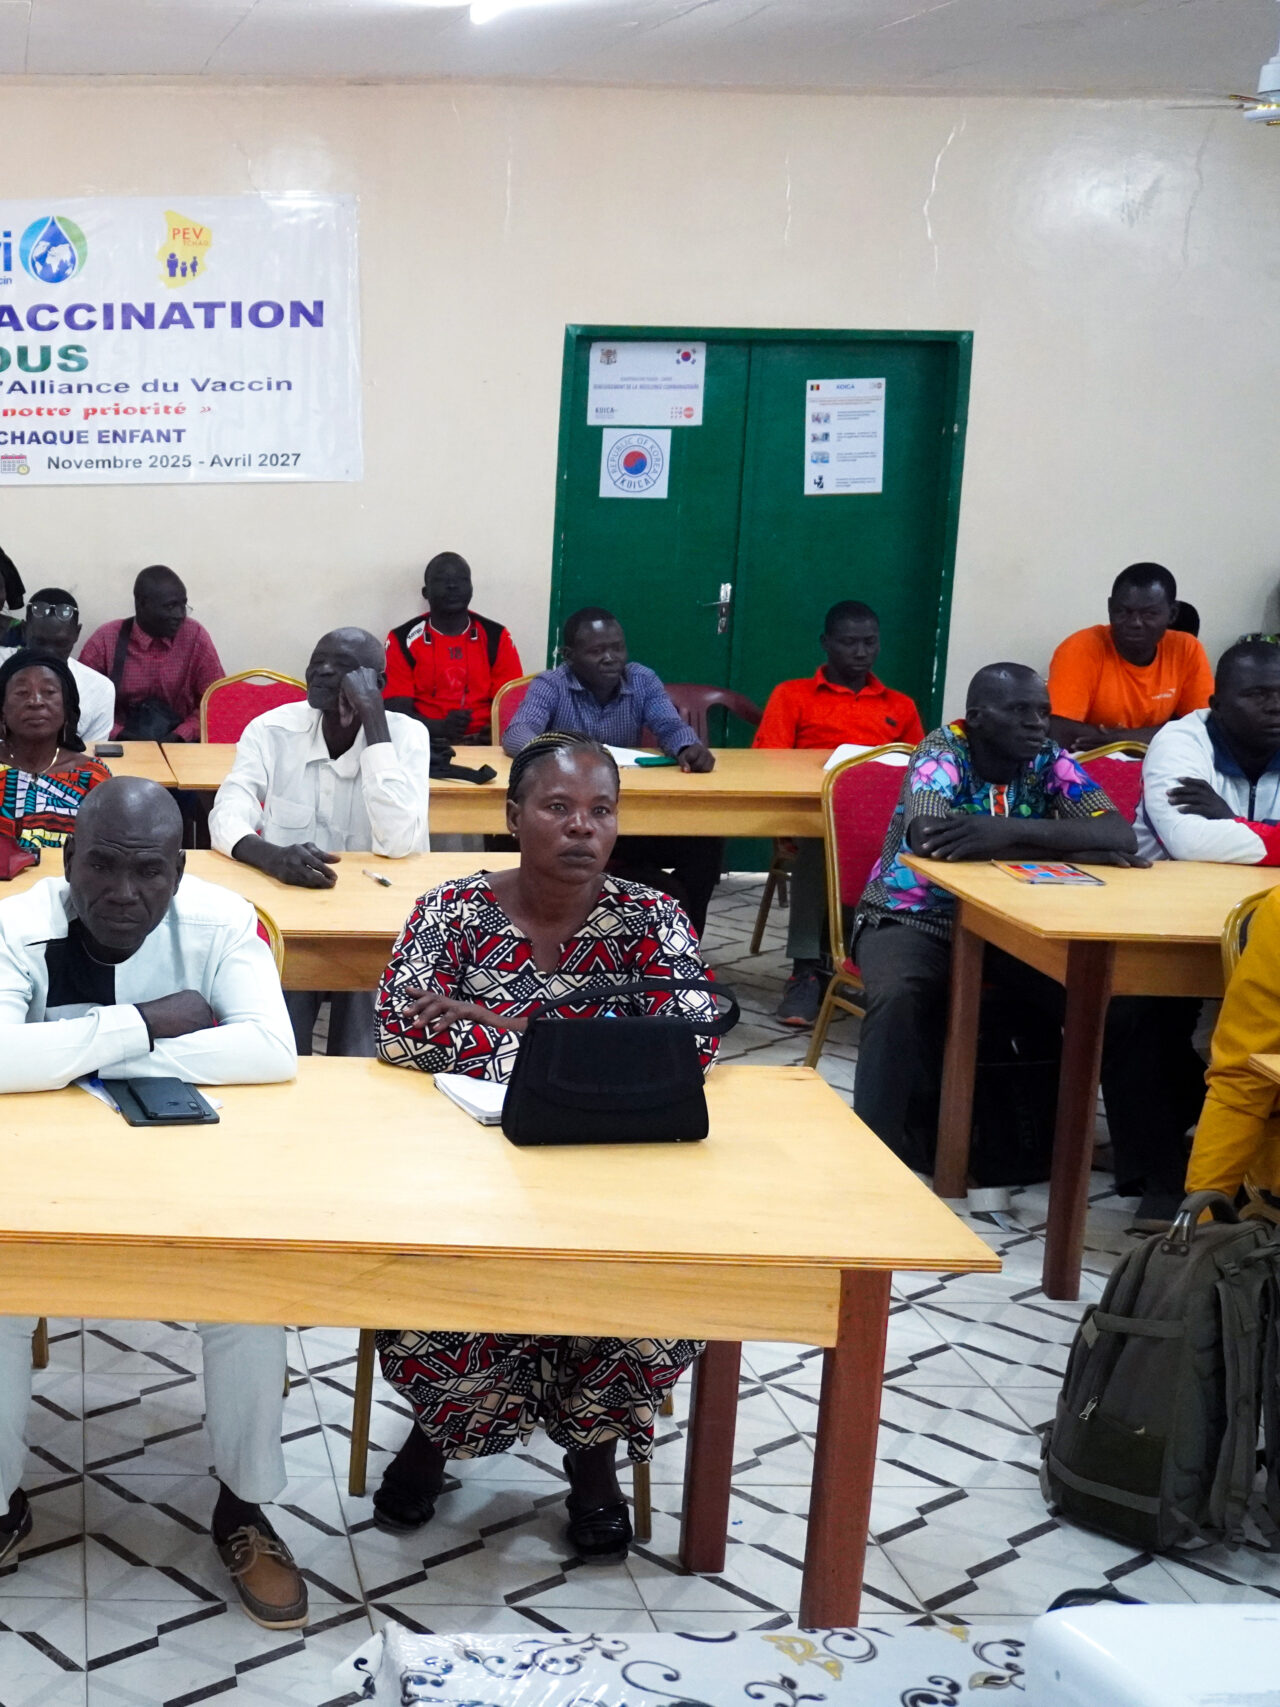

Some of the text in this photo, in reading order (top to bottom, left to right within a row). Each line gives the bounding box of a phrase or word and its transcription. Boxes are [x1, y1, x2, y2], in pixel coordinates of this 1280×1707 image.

[172, 227, 204, 240] PEV
[142, 379, 178, 392] du
[191, 377, 292, 392] Vaccin
[3, 407, 71, 416] notre
[83, 403, 186, 420] priorité
[98, 429, 186, 444] ENFANT
[48, 456, 142, 469] Novembre
[149, 455, 191, 468] 2025
[210, 454, 251, 467] Avril
[259, 453, 301, 466] 2027
[609, 437, 633, 475] REPUBLIC
[649, 445, 661, 474] KOREA
